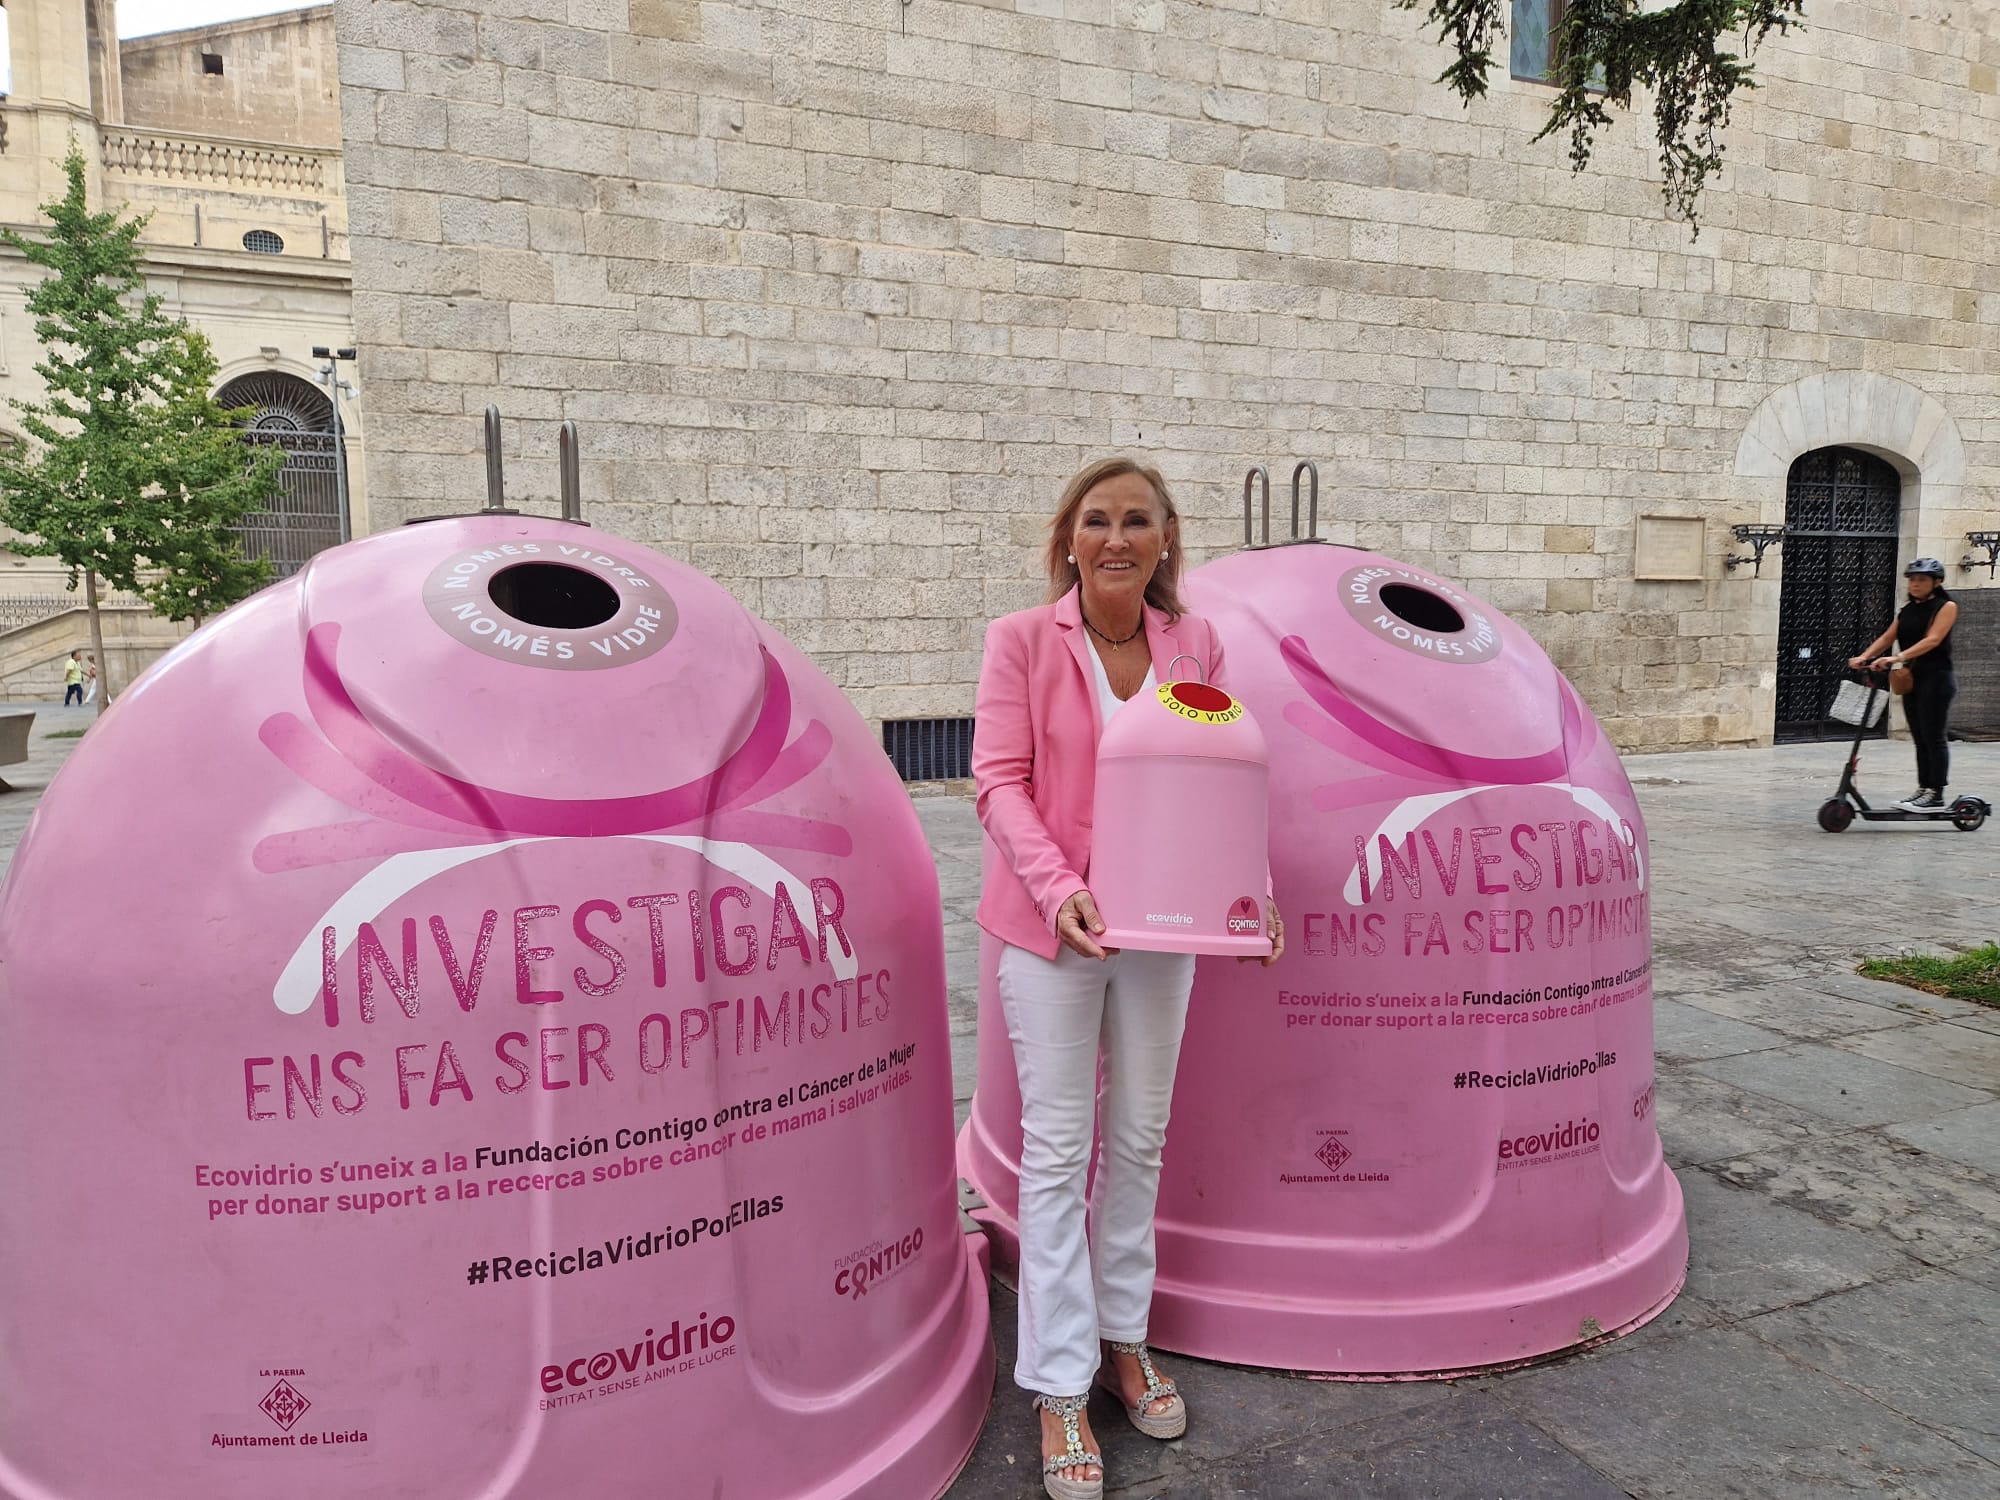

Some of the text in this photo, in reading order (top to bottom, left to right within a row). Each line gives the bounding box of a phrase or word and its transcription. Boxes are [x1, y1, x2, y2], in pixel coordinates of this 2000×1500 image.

[444, 543, 651, 589] NOMÉS VIDRE
[451, 601, 661, 660] NOMÉS VIDRE
[1373, 611, 1494, 656] NOMÉS VIDRE
[1162, 697, 1242, 722] SOLO VIDRIO
[1353, 818, 1639, 904] INVESTIGAR
[1145, 911, 1194, 925] ecovidrio
[1303, 912, 1386, 957] ENS
[1404, 911, 1450, 956] FA
[1463, 909, 1535, 954] SER
[322, 876, 852, 1028] INVESTIGAR
[1278, 991, 1362, 1007] Ecovidrio
[1366, 992, 1427, 1008] s'uneix
[1431, 995, 1441, 1007] a
[1445, 991, 1459, 1006] la
[1462, 988, 1541, 1006] Fundación
[1544, 982, 1590, 1001] Contigo
[1615, 970, 1623, 985] el
[1287, 1013, 1316, 1028] per
[1321, 1012, 1373, 1027] donar
[1376, 1012, 1433, 1030] suport
[1437, 1014, 1447, 1026] a
[1451, 1011, 1465, 1025] la
[1468, 1011, 1529, 1025] recerca
[1532, 1004, 1568, 1022] sobre
[1600, 993, 1611, 1007] de
[244, 968, 891, 1123] ENS FA SER OPTIMISTES
[195, 1042, 916, 1187] Ecovidrio s'uneix a la Fundación Contigo contra el Cáncer de la Mujer
[1498, 1116, 1600, 1159] ecovidrio
[208, 1198, 249, 1221] per
[255, 1193, 330, 1215] donar
[337, 1184, 427, 1215] suport
[434, 1184, 451, 1202] a
[456, 1178, 480, 1200] la
[487, 1169, 586, 1197] recerca
[592, 1154, 664, 1183] sobre
[741, 1123, 767, 1144] de
[771, 1106, 827, 1136] mama
[830, 1099, 836, 1117] i
[838, 1083, 880, 1114] salvar
[882, 1068, 913, 1095] vides.
[1279, 1172, 1390, 1185] Ajuntament de Lleida
[834, 1226, 924, 1301] CONTIGO
[259, 1368, 306, 1377] LA PAERIA
[540, 1311, 736, 1394] ecovidrio
[539, 1344, 737, 1411] ENTITAT SENSE ÀNIM DE LUCRE
[211, 1429, 369, 1449] Ajuntament de Lleida
